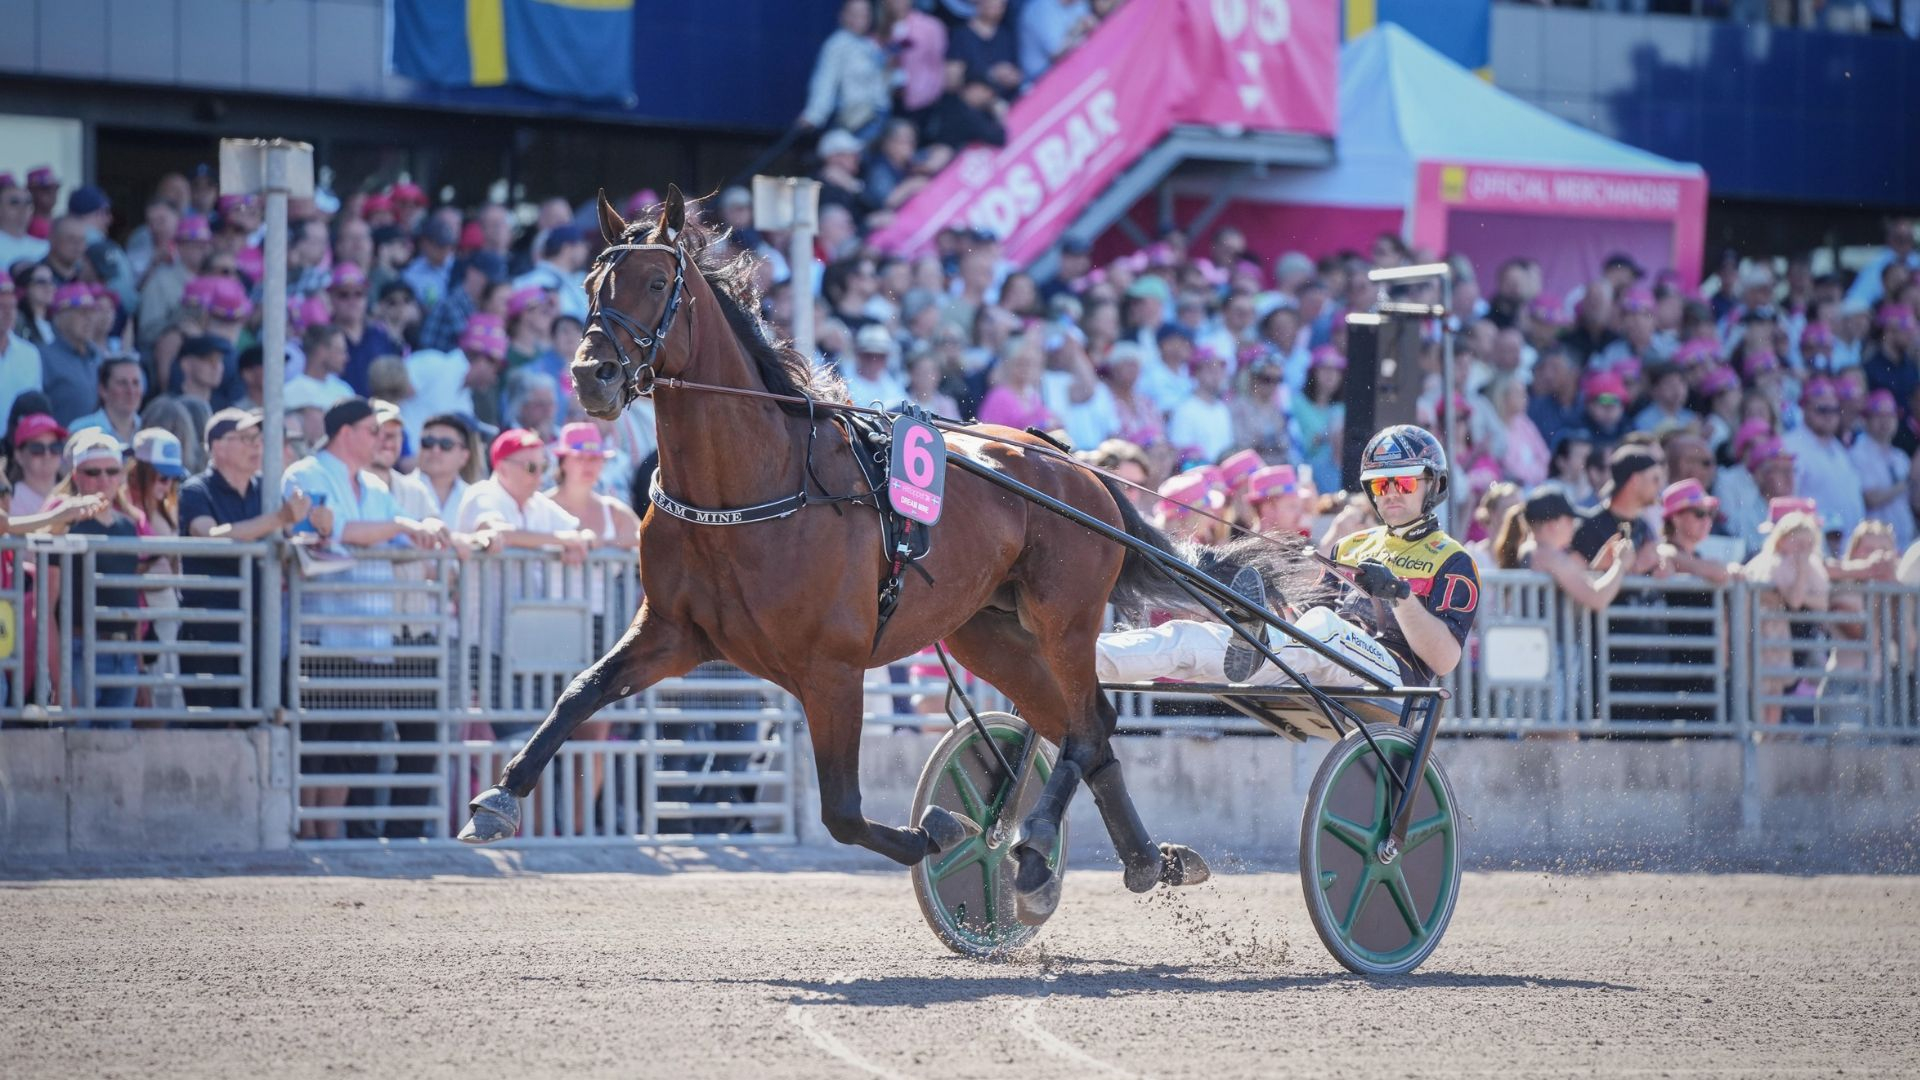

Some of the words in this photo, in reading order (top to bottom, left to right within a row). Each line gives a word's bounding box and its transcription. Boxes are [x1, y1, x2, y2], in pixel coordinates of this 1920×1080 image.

[1034, 89, 1120, 191] BAR
[1471, 171, 1547, 202] OFFICIAL
[1554, 177, 1679, 209] MERCHANDISE
[903, 425, 935, 489] 6
[695, 512, 743, 524] MINE
[1436, 574, 1478, 612] D
